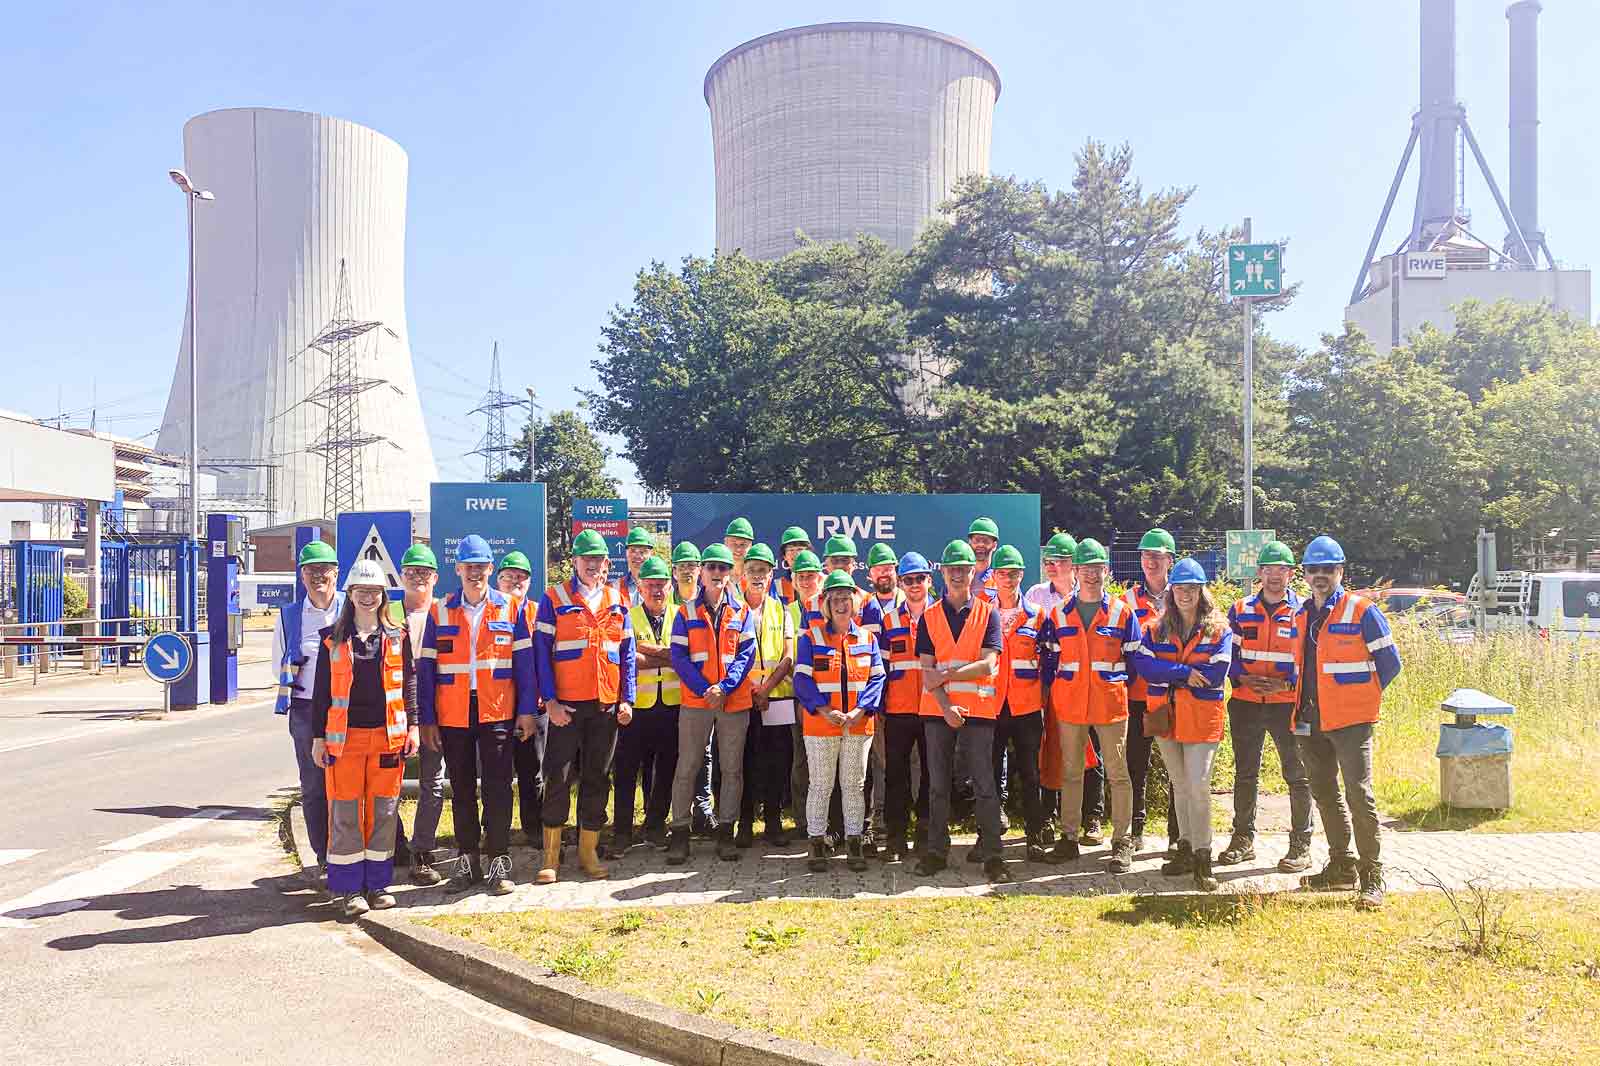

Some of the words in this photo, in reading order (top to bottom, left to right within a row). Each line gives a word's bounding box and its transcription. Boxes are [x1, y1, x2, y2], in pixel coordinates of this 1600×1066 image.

[1409, 258, 1444, 270] RWE
[466, 498, 507, 511] RWE
[586, 505, 614, 514] RWE
[582, 521, 619, 529] Wegweiser
[817, 515, 896, 539] RWE
